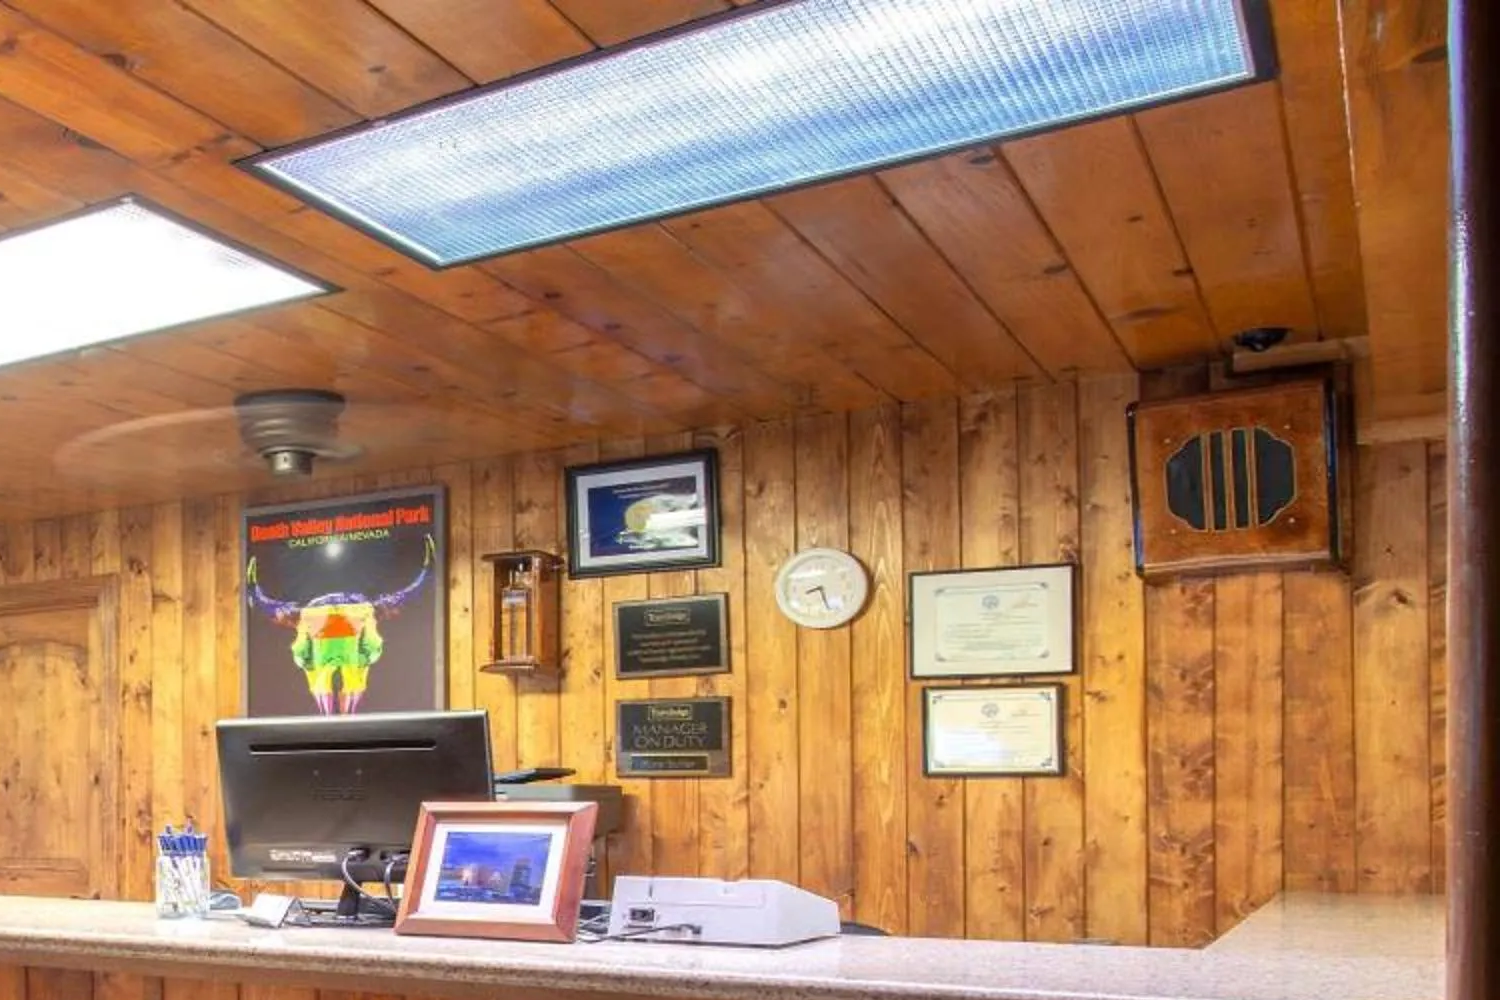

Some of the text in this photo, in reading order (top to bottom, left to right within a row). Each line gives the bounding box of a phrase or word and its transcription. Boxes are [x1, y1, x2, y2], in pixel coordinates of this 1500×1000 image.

[251, 504, 430, 541] Death Valley National Park
[632, 721, 709, 737] MANAGER
[634, 734, 706, 749] ON DUTY
